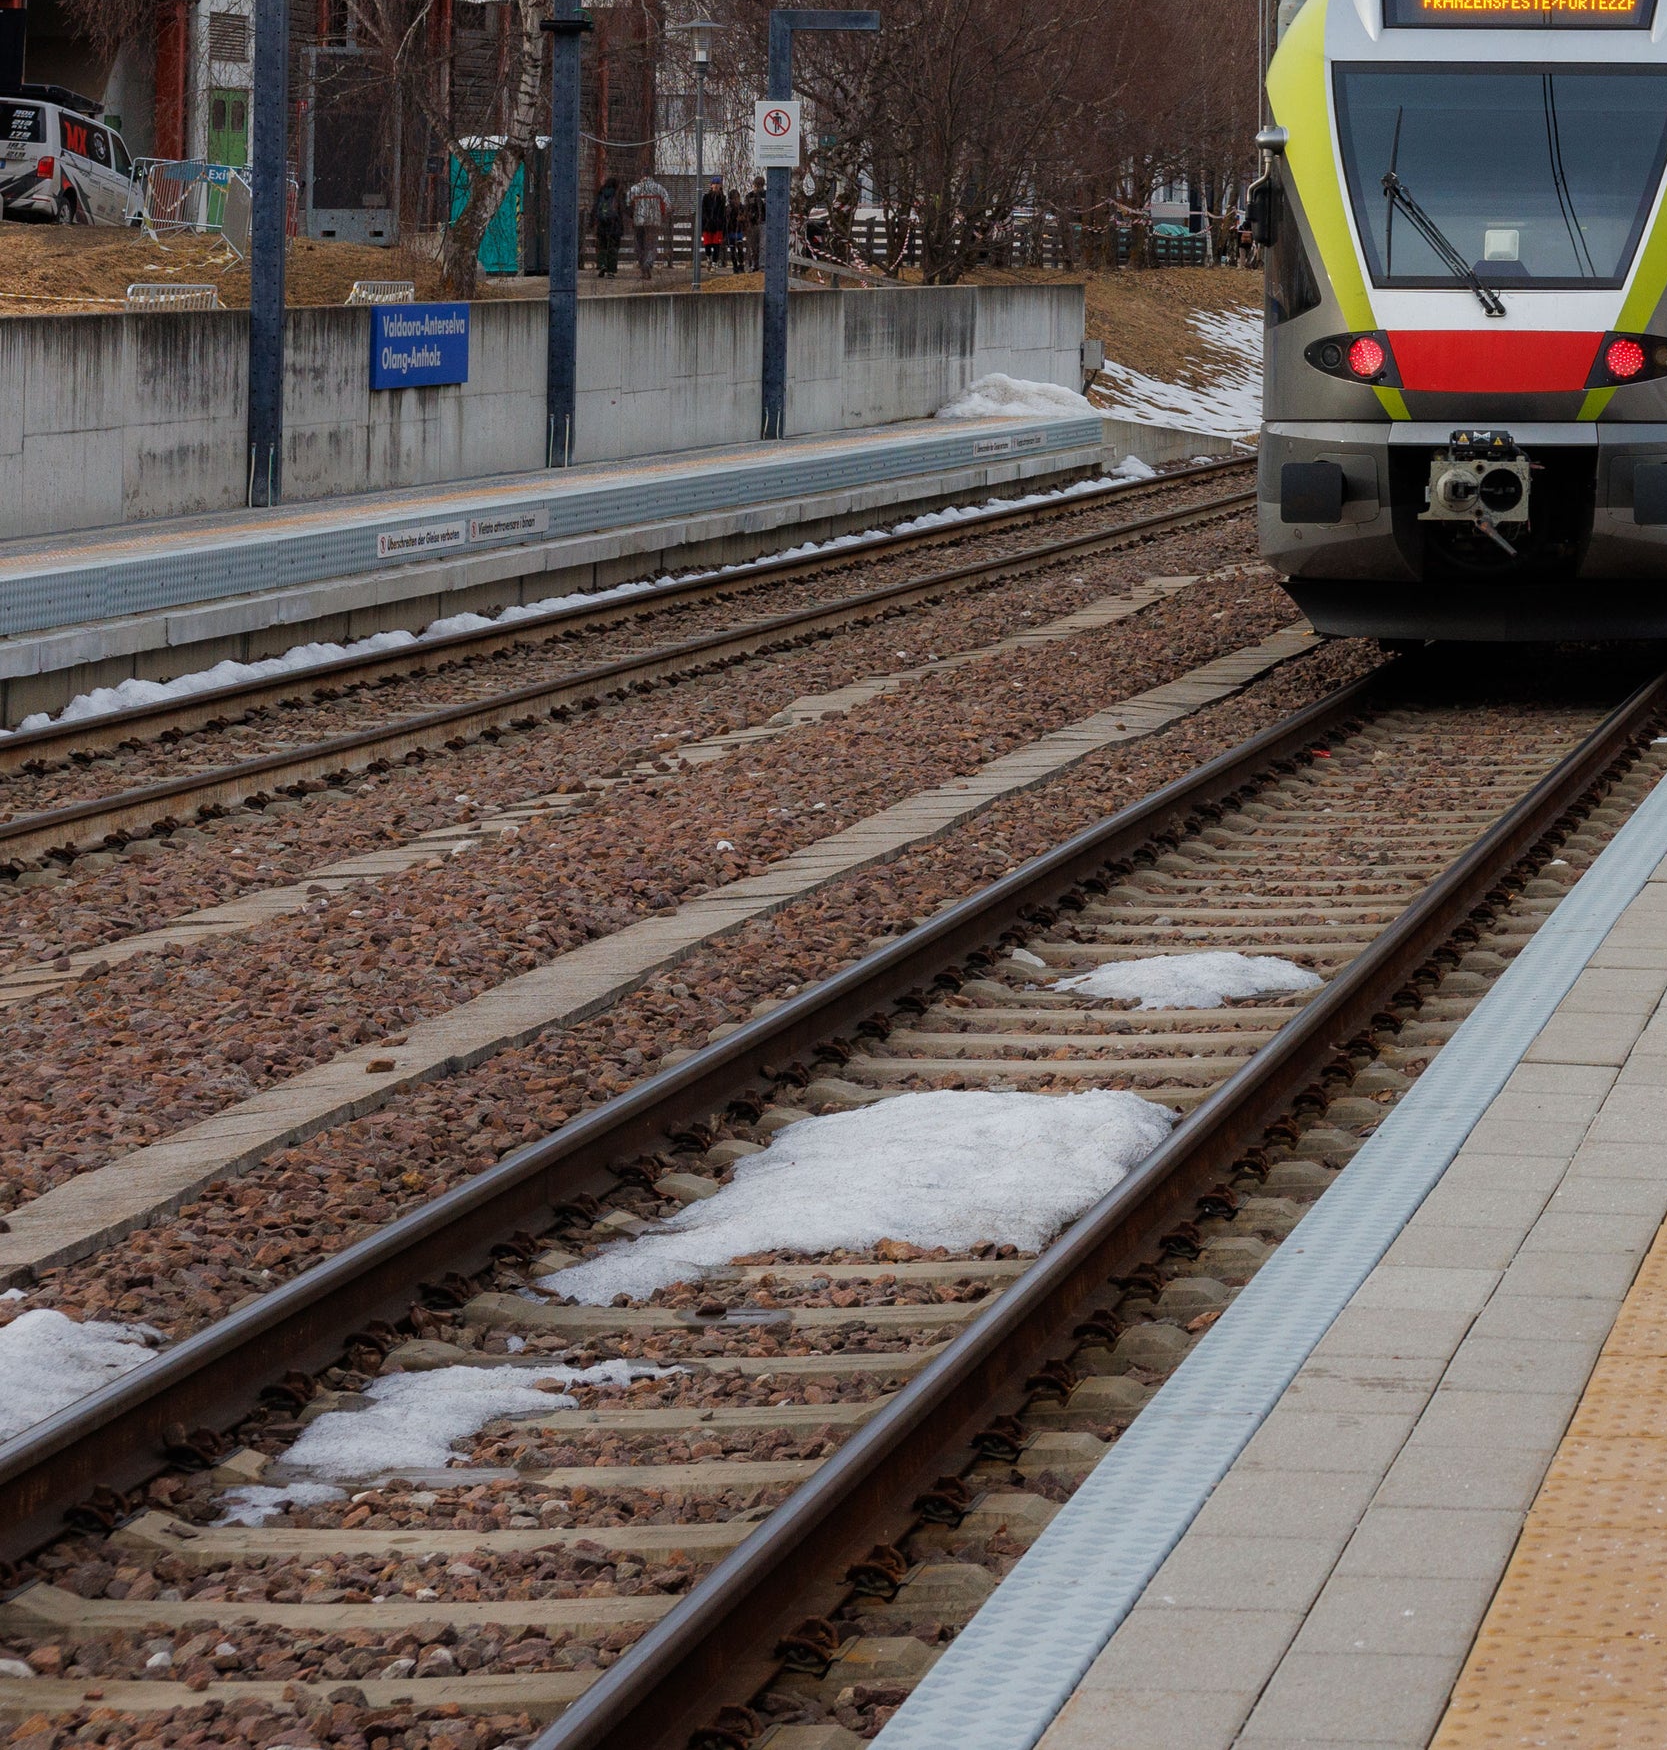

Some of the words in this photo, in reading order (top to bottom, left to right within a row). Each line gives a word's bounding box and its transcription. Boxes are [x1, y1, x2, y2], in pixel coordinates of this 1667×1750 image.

[208, 169, 229, 181] Exi
[383, 311, 465, 338] Valdaora-Anterselva
[382, 343, 441, 375] Olang-Antholz
[440, 529, 460, 542] verboten
